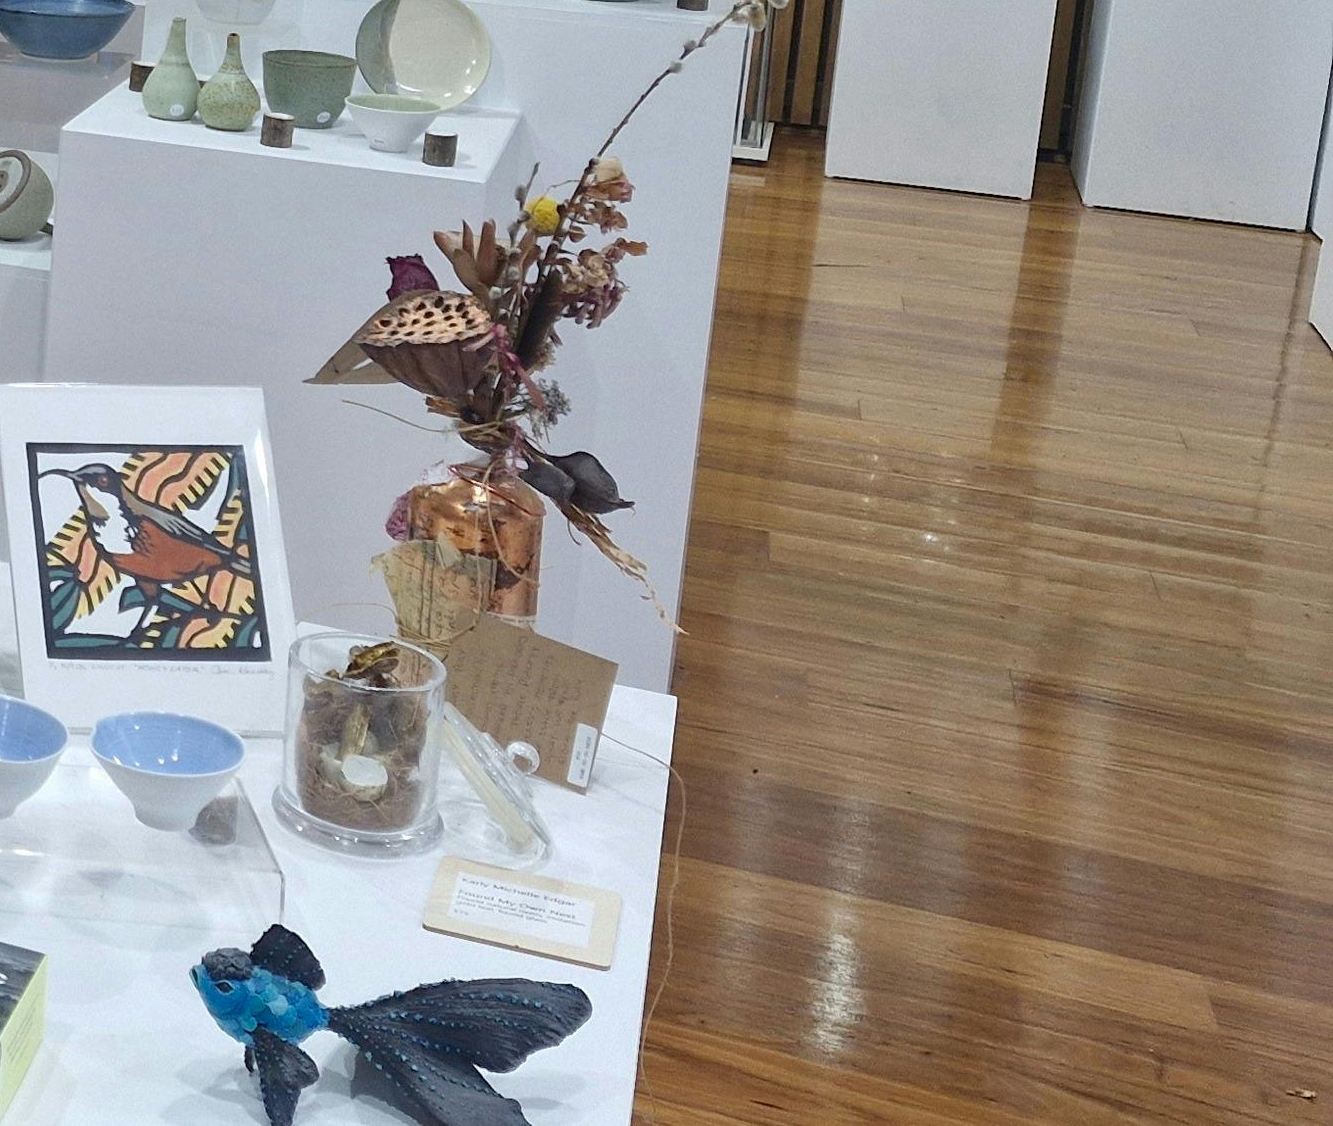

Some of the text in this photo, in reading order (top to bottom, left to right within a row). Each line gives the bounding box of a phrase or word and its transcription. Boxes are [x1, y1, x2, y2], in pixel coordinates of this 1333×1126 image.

[459, 889, 494, 902] Found
[498, 897, 517, 907] My
[519, 903, 546, 914] Own
[493, 884, 541, 899] Michelle
